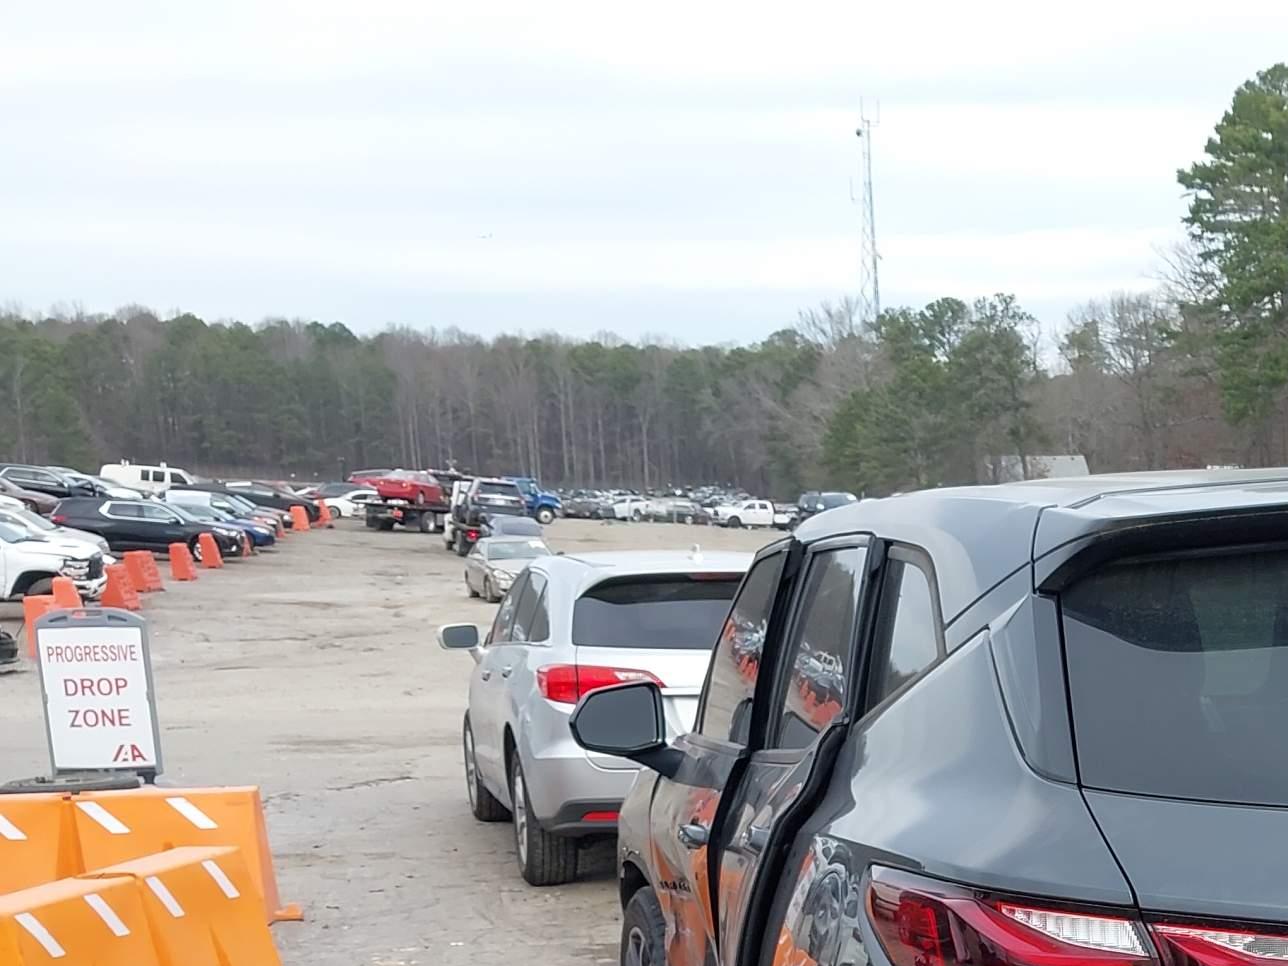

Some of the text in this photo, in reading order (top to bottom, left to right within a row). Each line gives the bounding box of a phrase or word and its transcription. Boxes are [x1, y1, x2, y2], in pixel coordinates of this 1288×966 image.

[46, 644, 138, 663] PROGRESSIVE
[63, 677, 128, 697] DROP
[68, 708, 132, 728] ZONE
